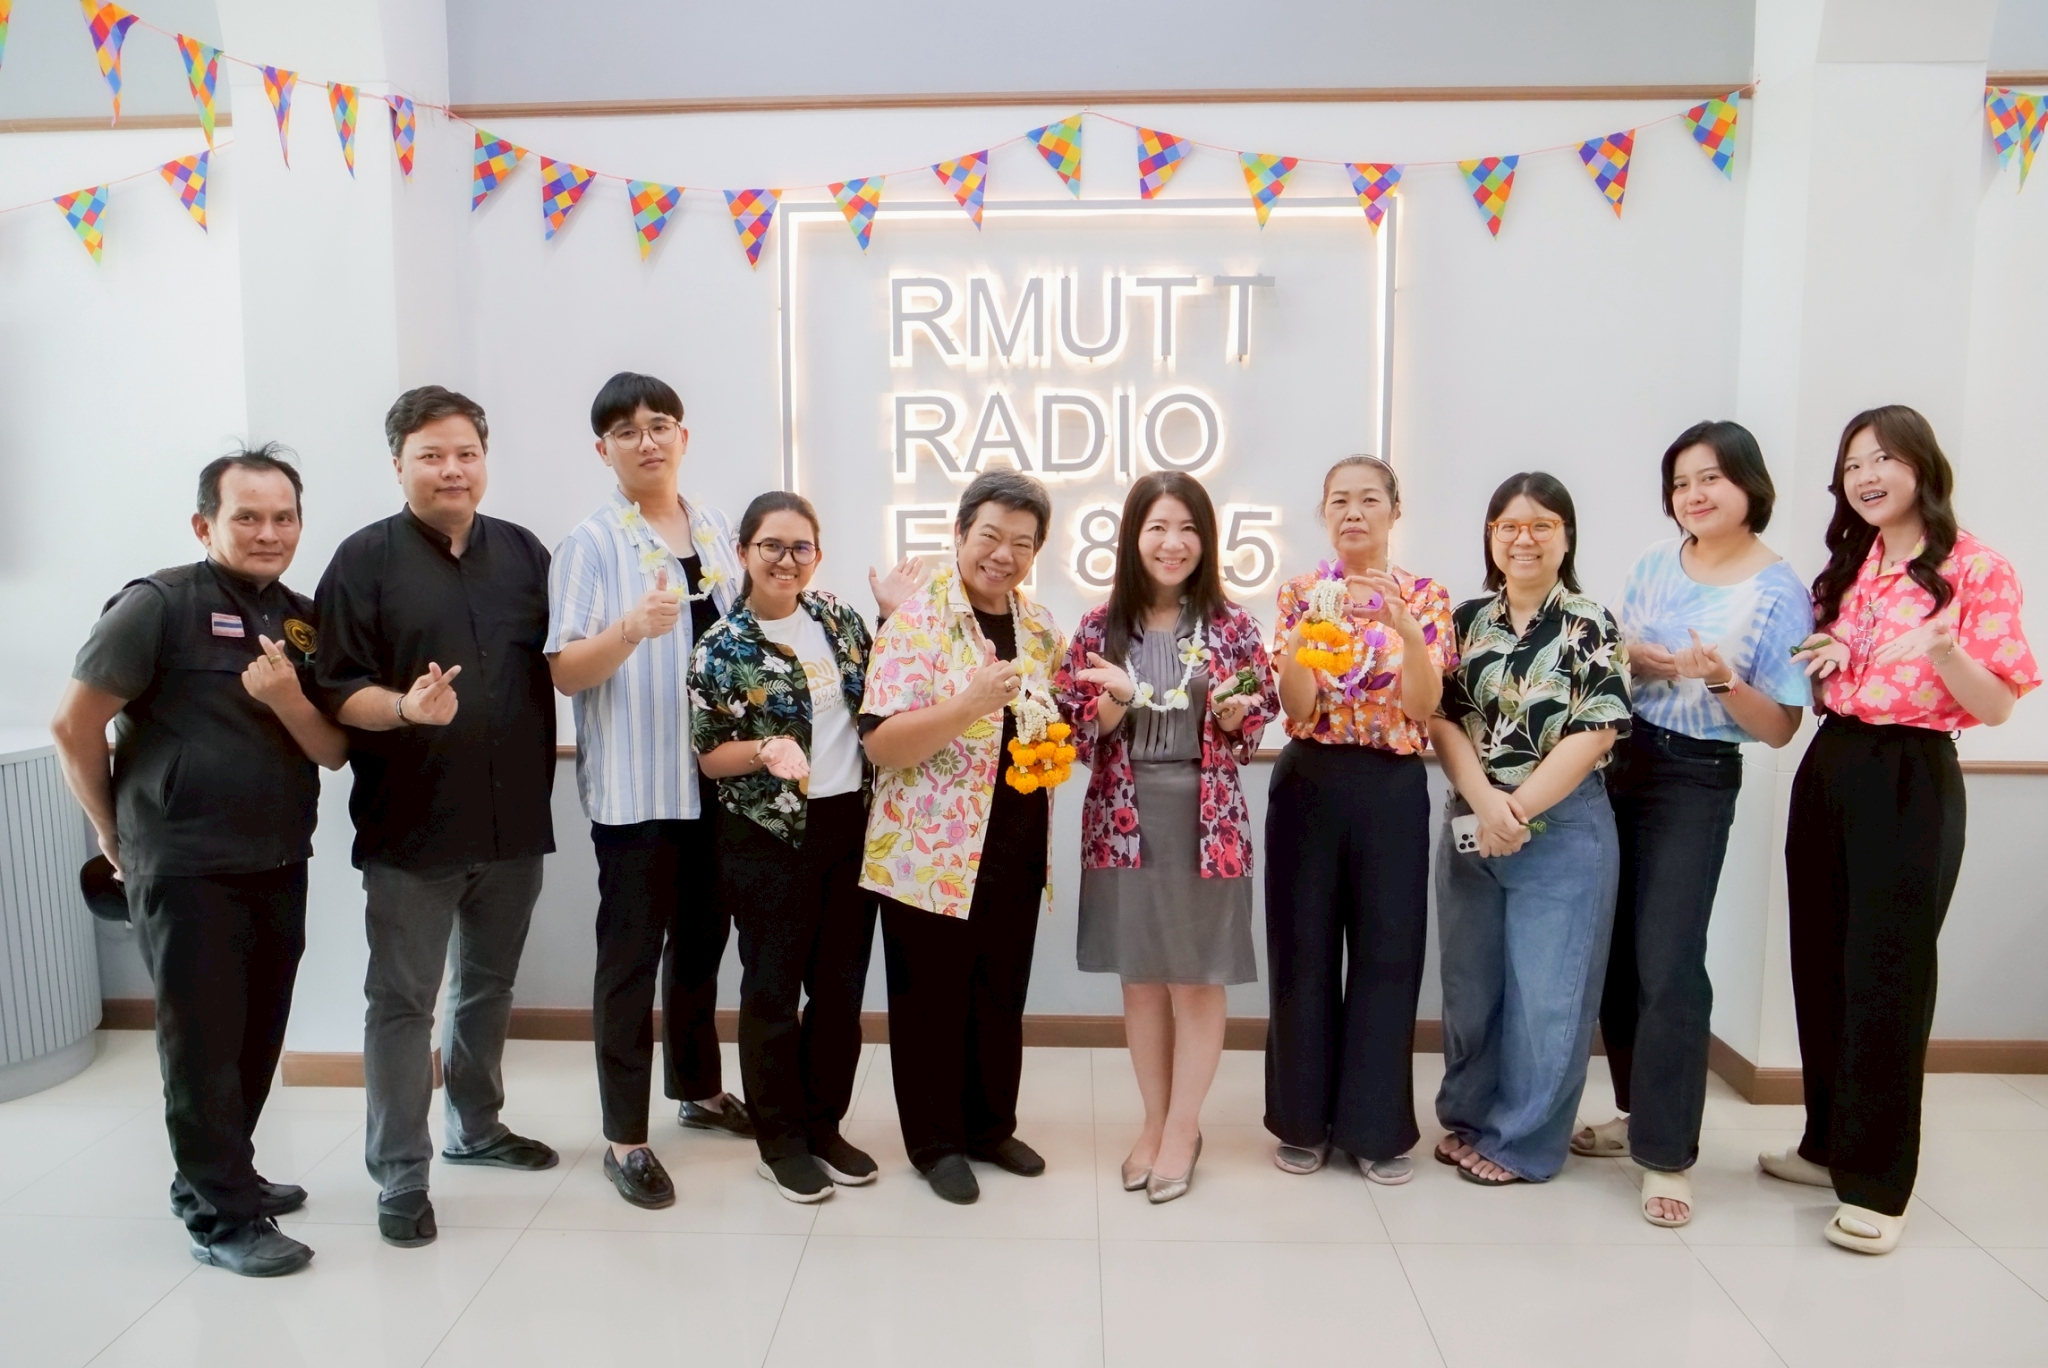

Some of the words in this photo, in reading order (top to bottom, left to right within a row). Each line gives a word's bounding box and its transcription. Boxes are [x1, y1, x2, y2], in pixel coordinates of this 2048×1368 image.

[891, 275, 1275, 358] RMUTT
[895, 393, 1219, 474] RADIO
[814, 683, 838, 706] 89.5
